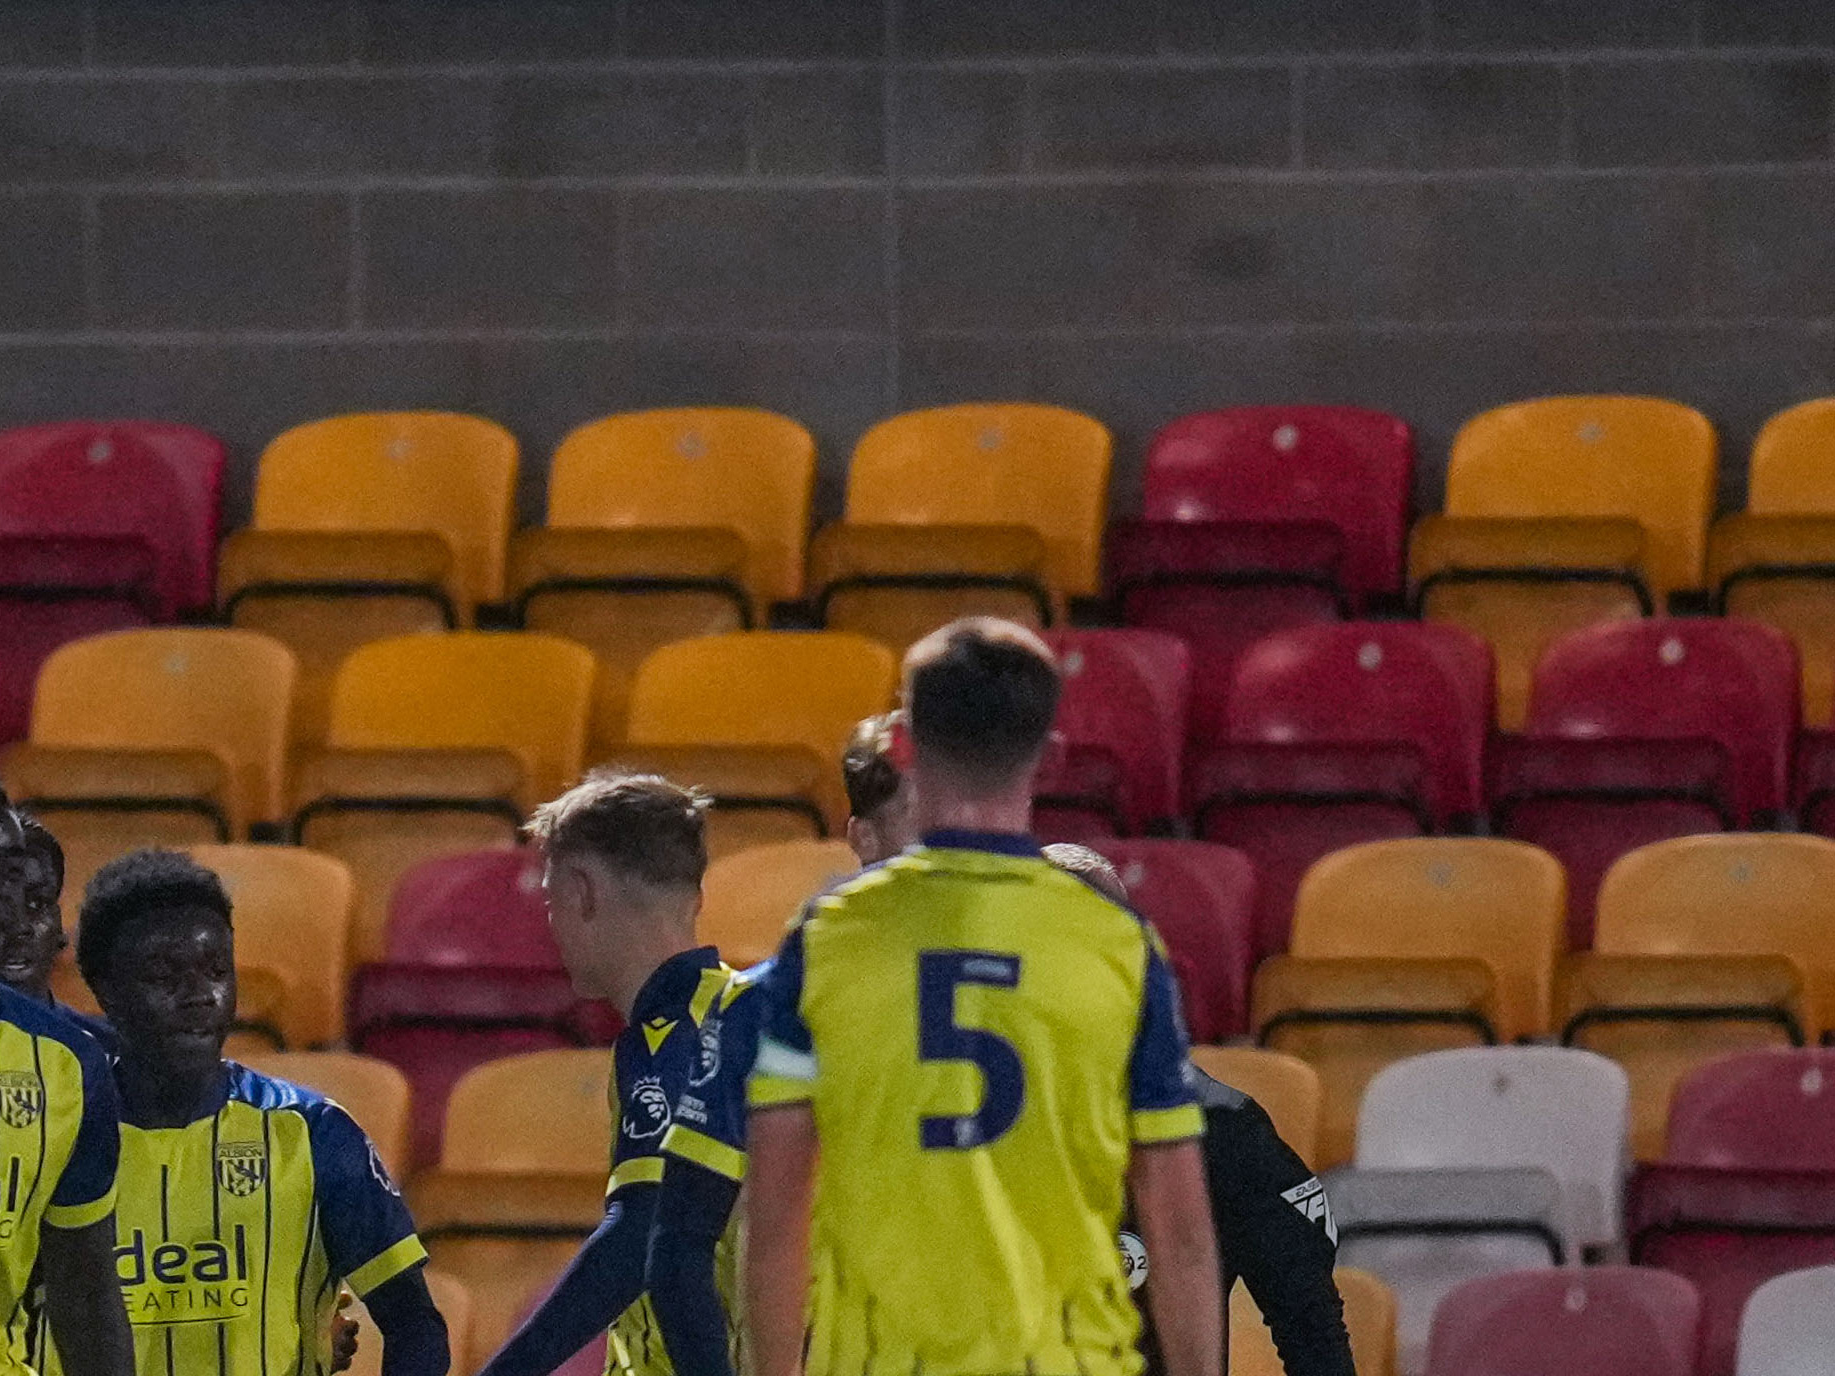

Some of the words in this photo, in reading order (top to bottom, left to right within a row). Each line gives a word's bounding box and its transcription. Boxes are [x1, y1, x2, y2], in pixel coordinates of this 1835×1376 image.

[918, 952, 1026, 1149] 5
[114, 1224, 248, 1287] deal
[121, 1286, 249, 1313] EATING
